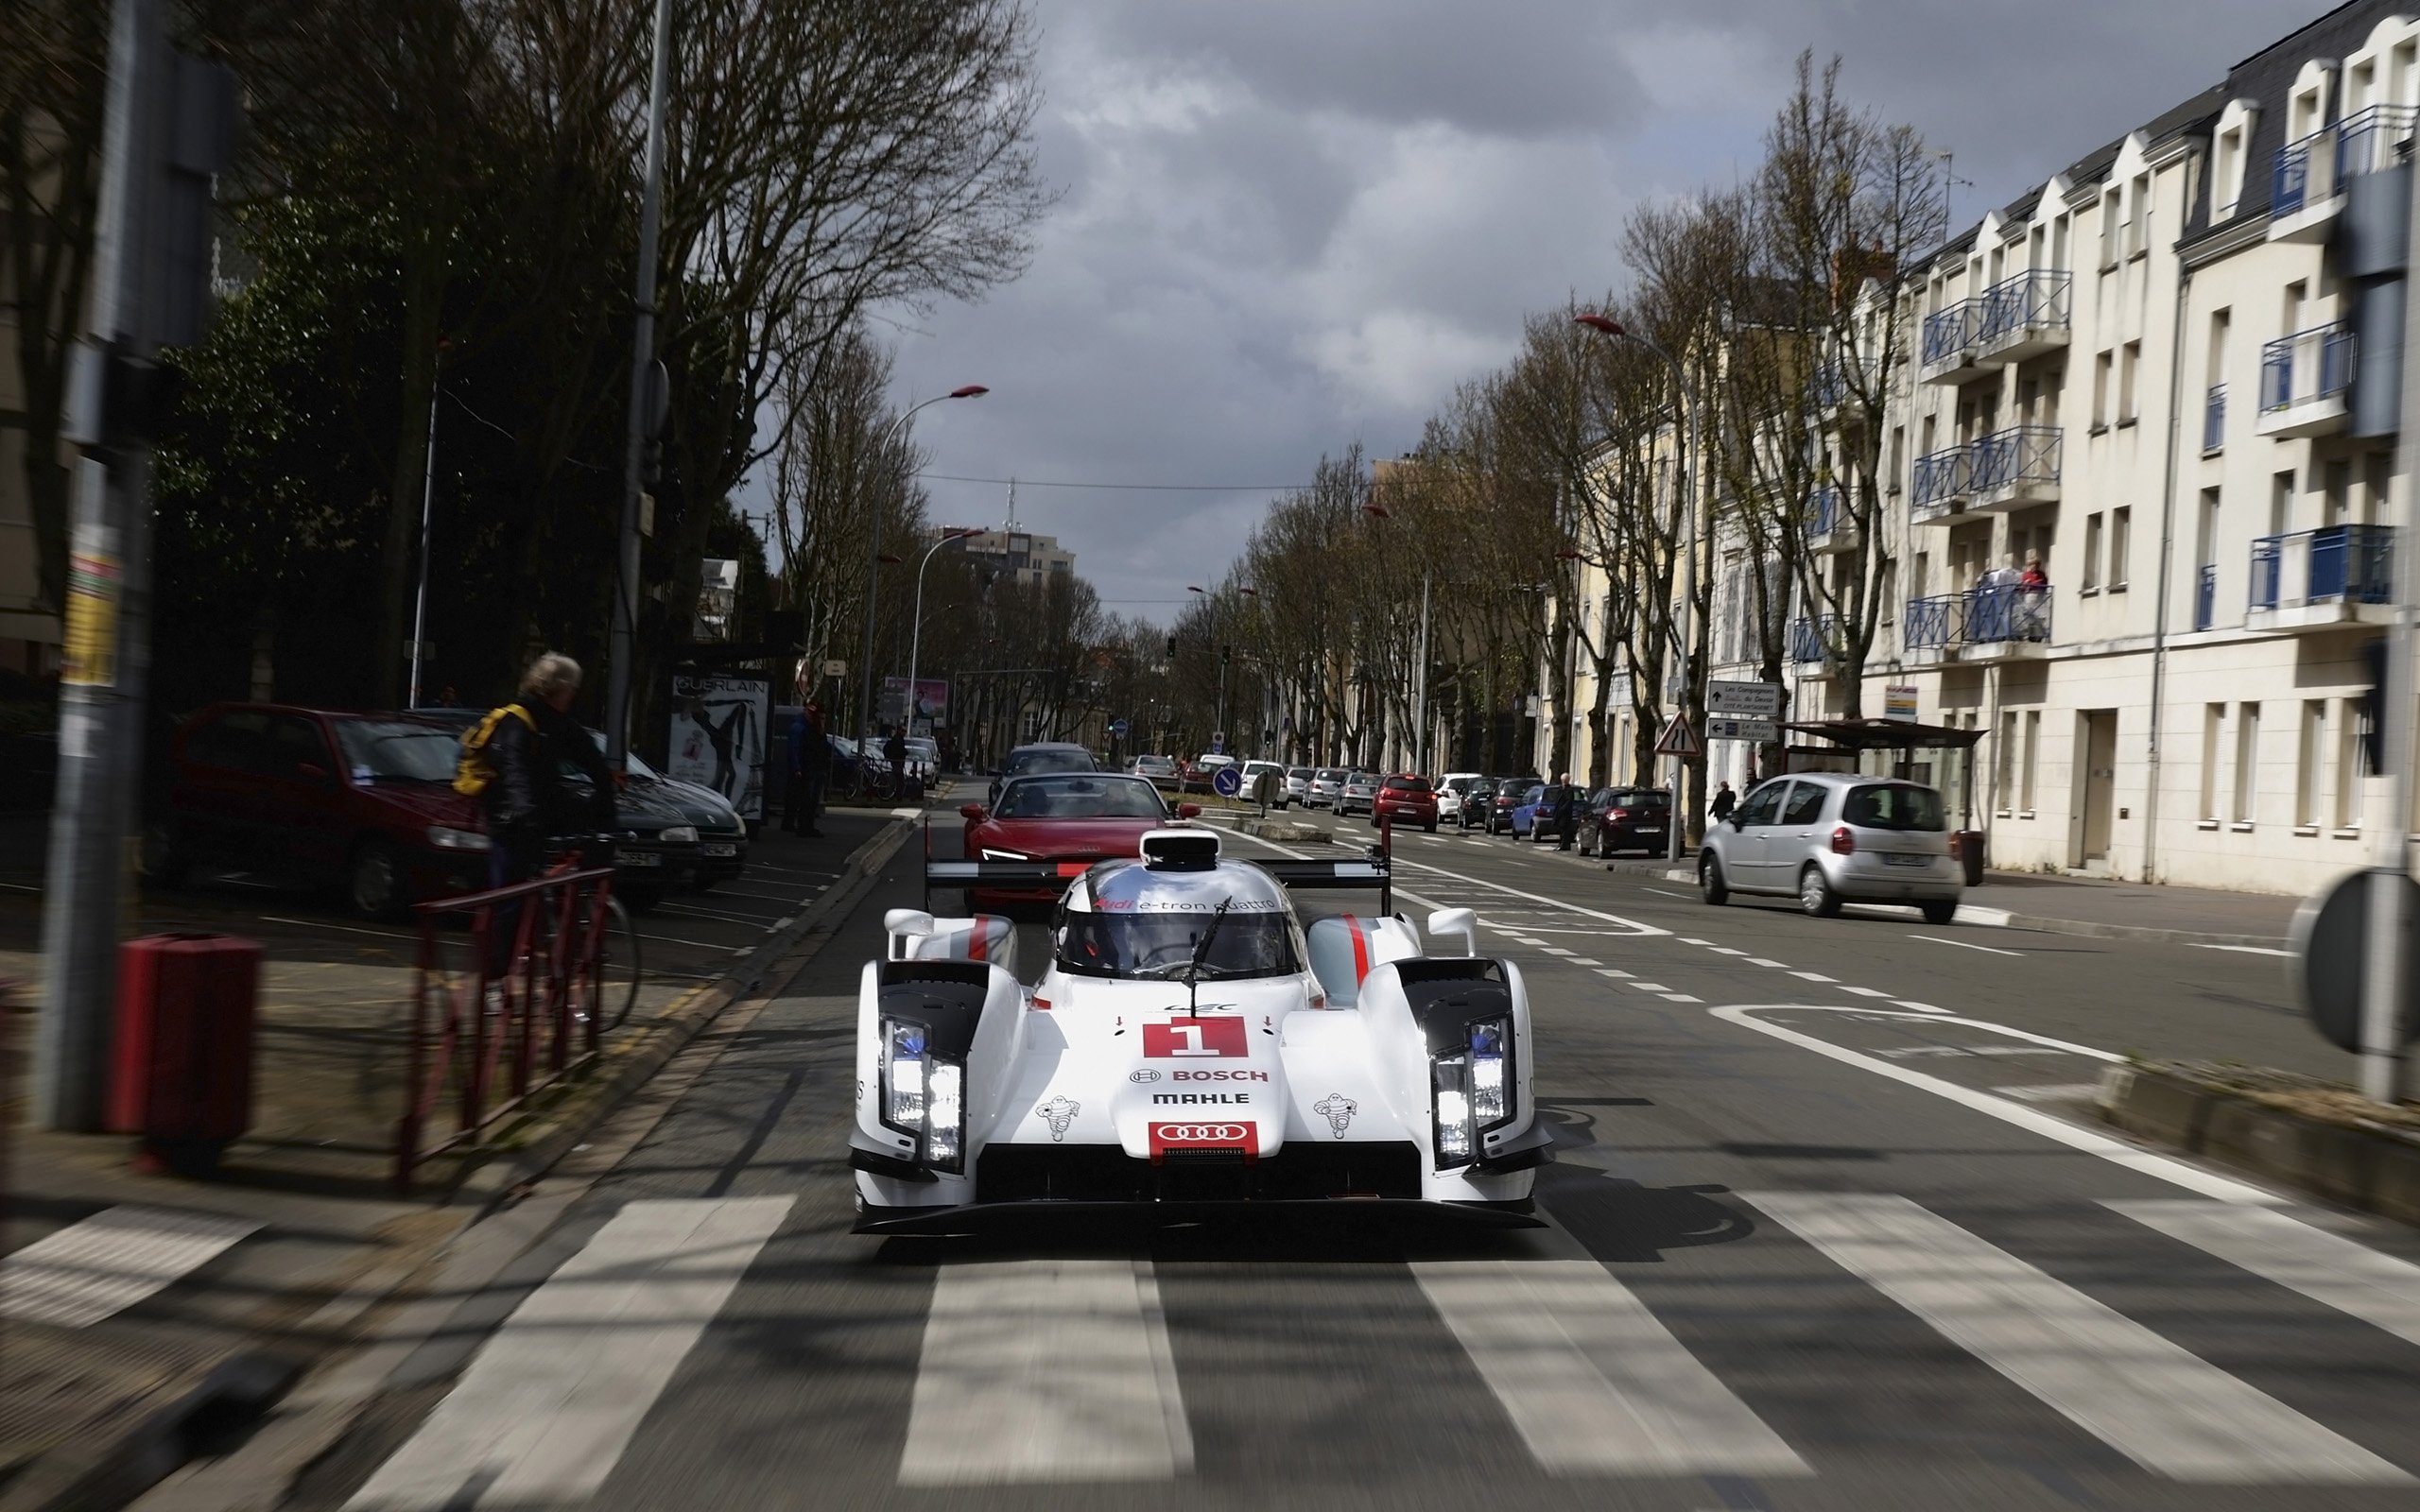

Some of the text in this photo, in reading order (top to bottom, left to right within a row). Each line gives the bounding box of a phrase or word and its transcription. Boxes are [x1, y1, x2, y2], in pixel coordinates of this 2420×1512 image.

[676, 677, 766, 694] GUERLAIN
[1737, 686, 1774, 696] Compagnons
[1093, 897, 1275, 913] Audi e-tron quattro
[1169, 1025, 1220, 1056] 1
[1172, 1071, 1269, 1082] BOSCH
[1152, 1093, 1250, 1104] MAHLE
